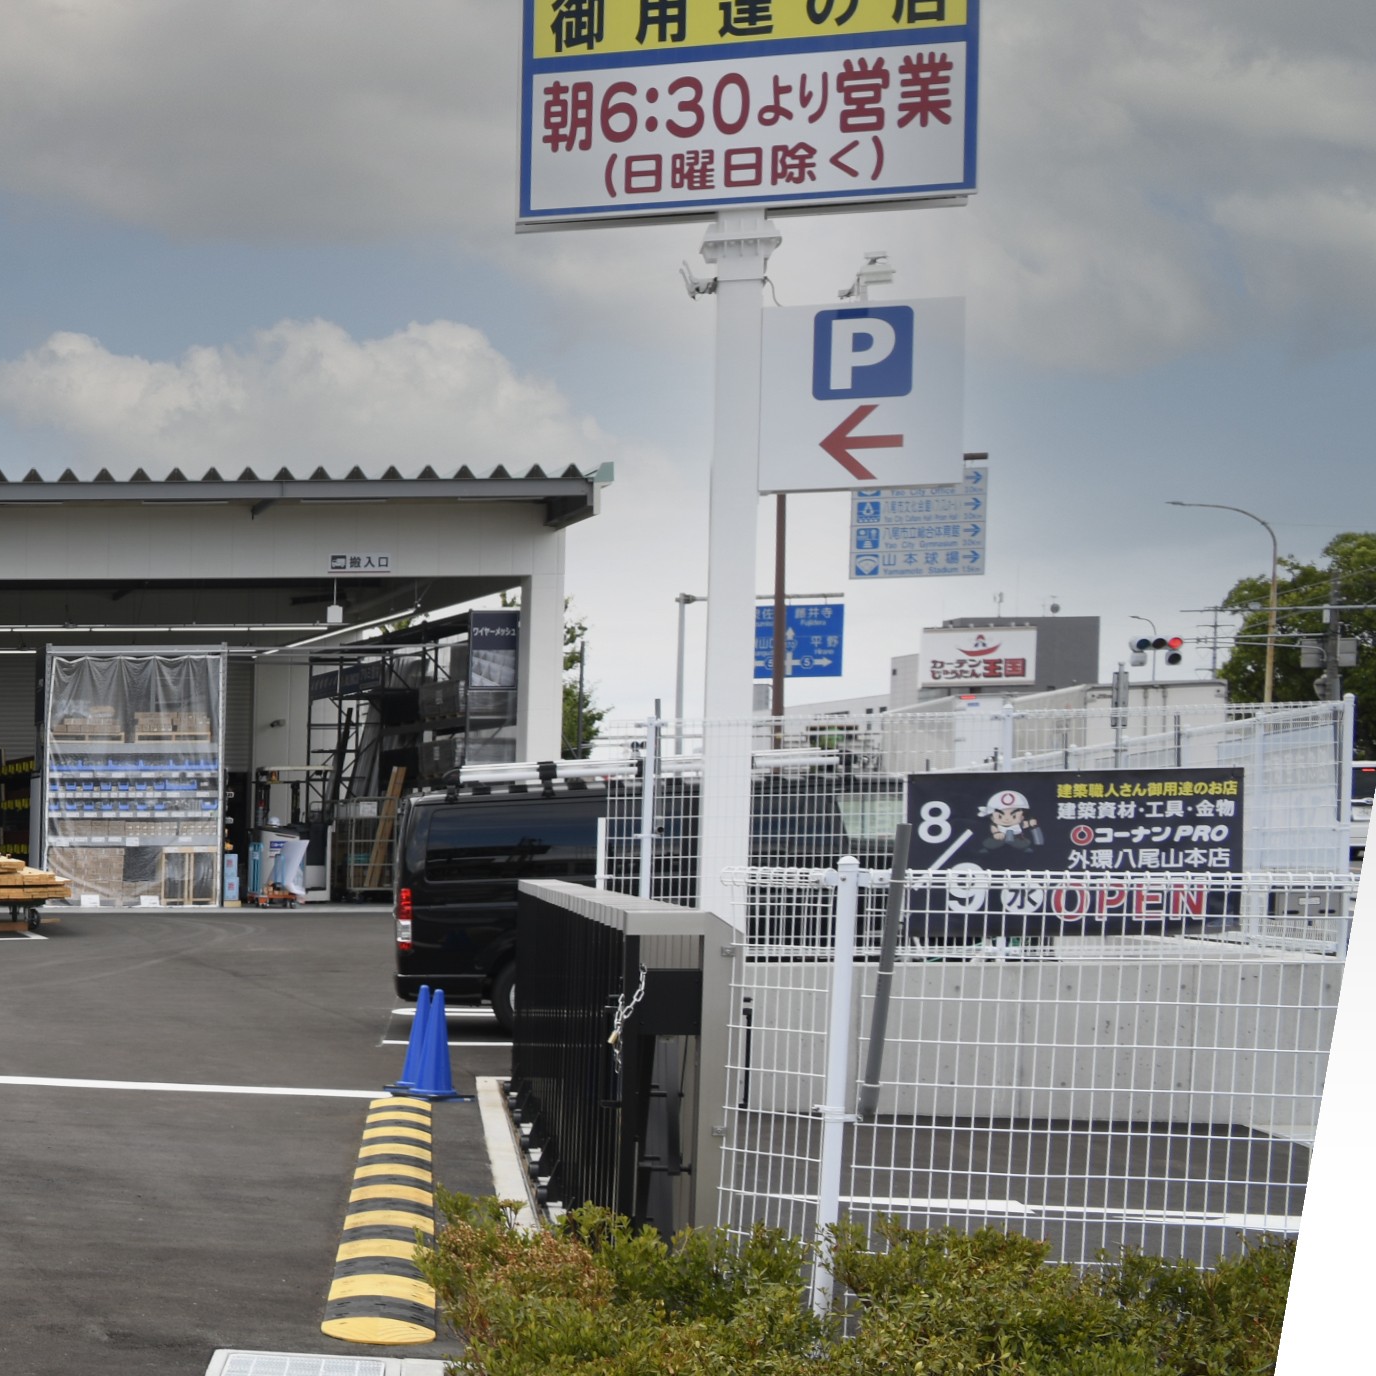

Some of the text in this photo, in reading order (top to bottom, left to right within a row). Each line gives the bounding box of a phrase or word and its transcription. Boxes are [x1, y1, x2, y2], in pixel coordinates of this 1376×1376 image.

[542, 52, 953, 152] 朝6:30より営業
[604, 135, 884, 198] (日曜日除く)
[830, 317, 896, 390] P
[349, 556, 389, 568] 搬入口
[472, 627, 517, 637] ワイヤーメッシュ
[982, 658, 1027, 678] 王国
[1056, 781, 1238, 799] 建築職人さん御用達のお店
[1094, 824, 1229, 843] コーナン PRO
[1067, 848, 1231, 869] 外環八尾山本店
[1051, 877, 1208, 922] OPEN
